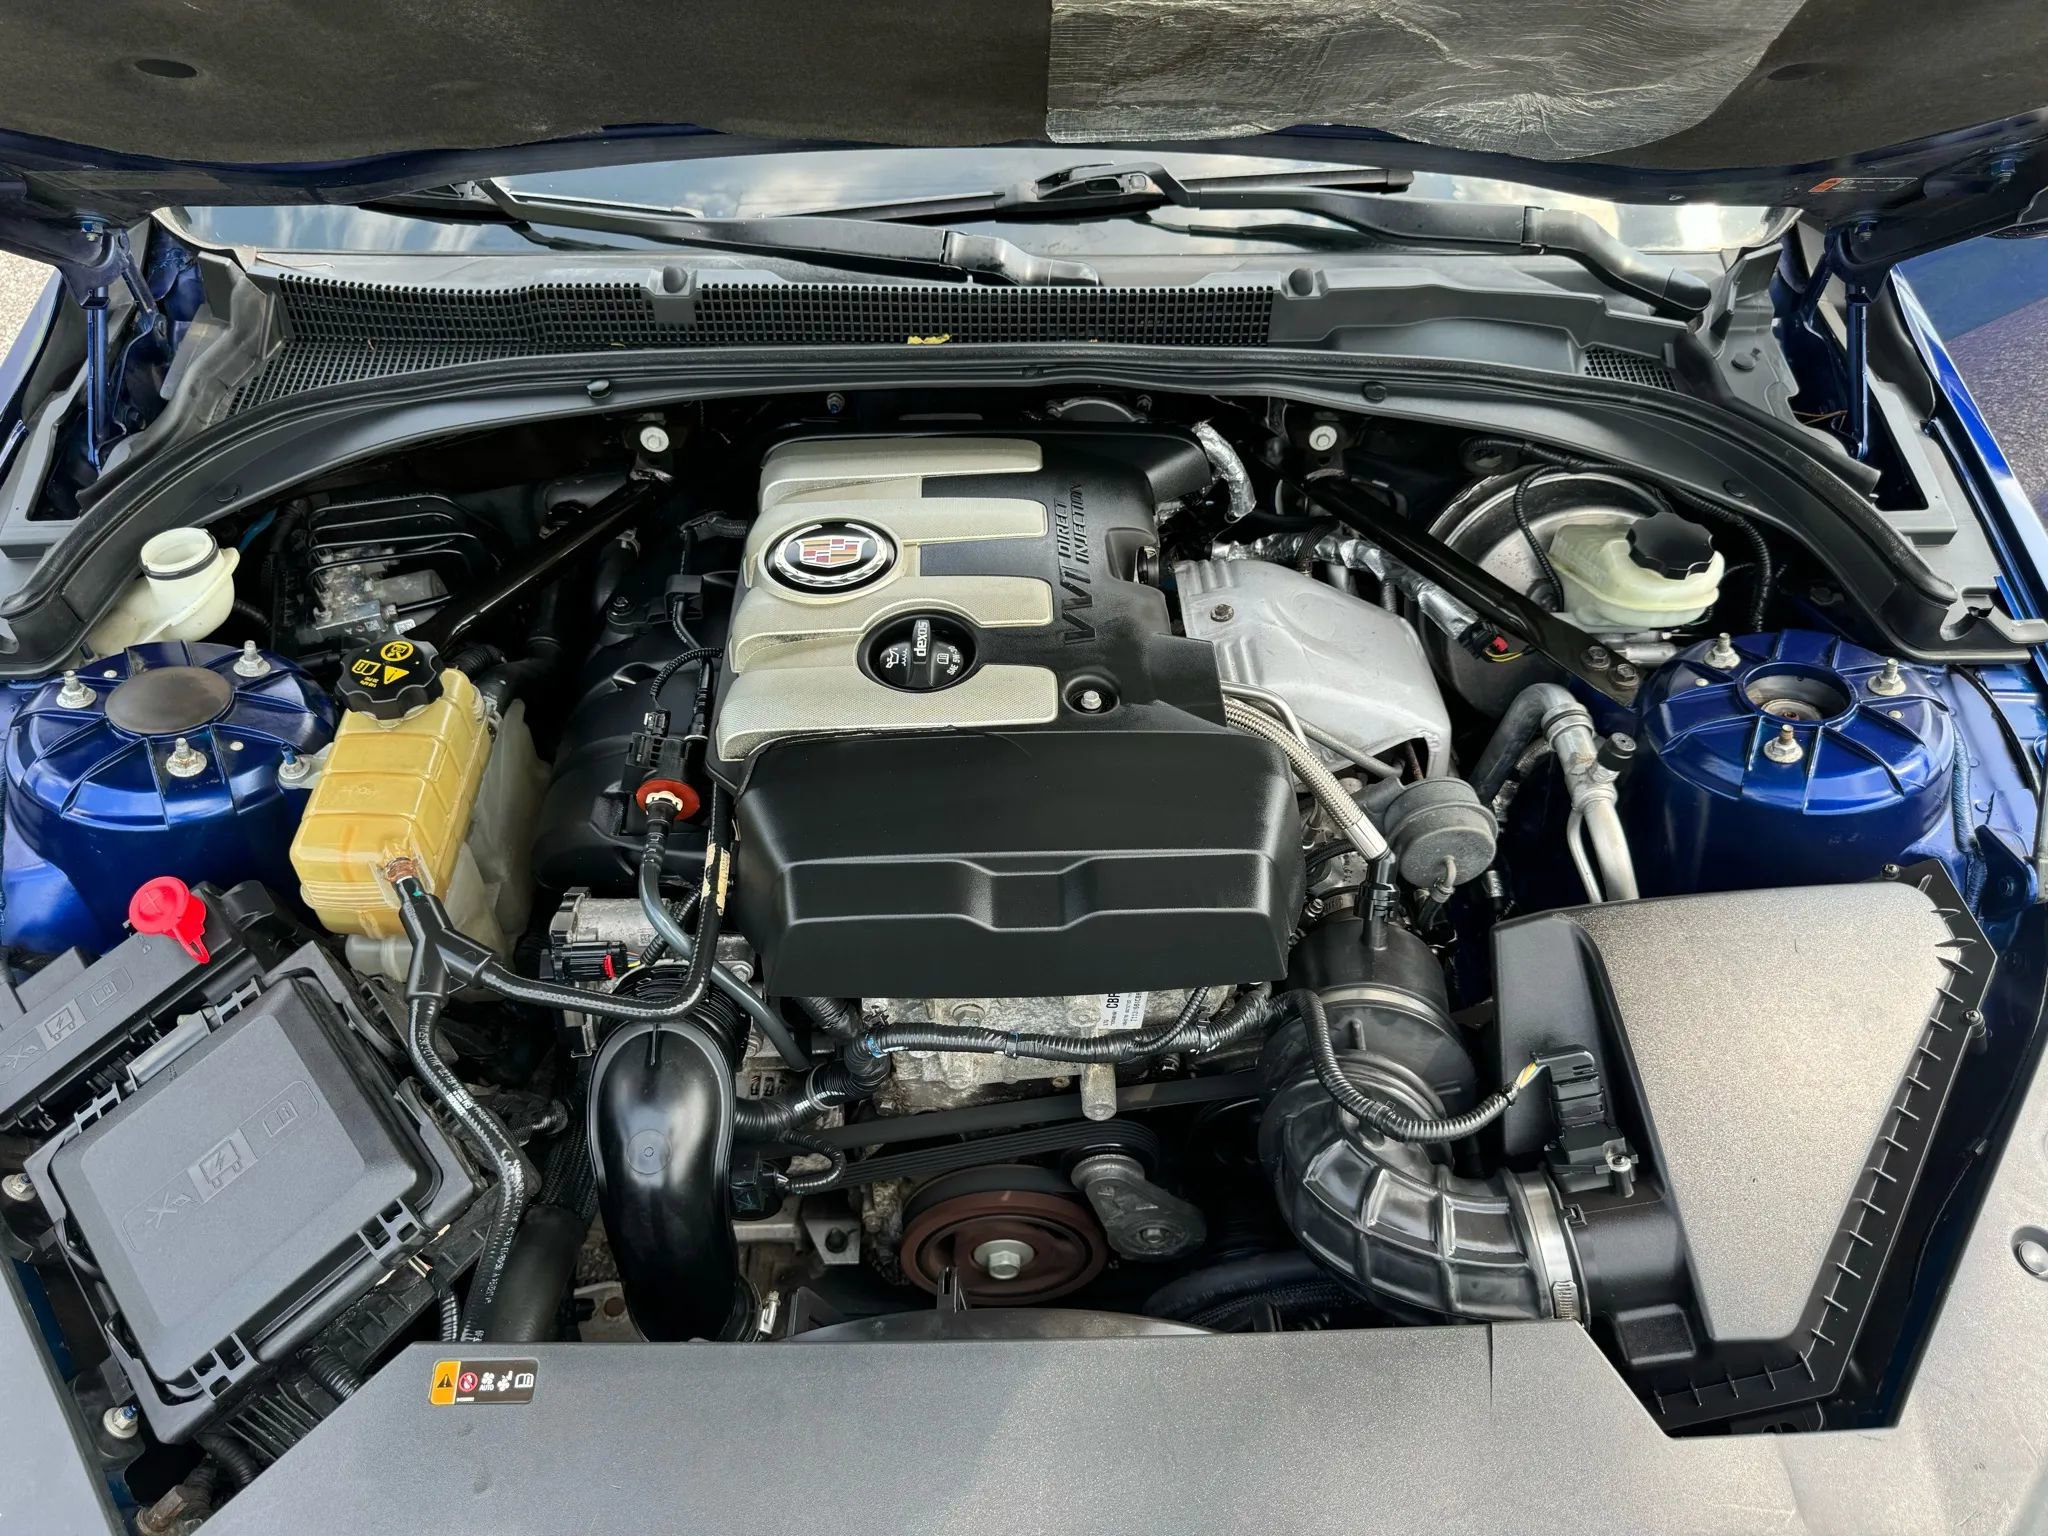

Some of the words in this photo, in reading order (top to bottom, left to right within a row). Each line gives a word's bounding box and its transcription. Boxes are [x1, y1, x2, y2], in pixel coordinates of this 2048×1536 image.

[1054, 497, 1072, 559] DIRECT
[1070, 483, 1090, 565] INJECTION
[1058, 558, 1096, 645] VVT
[913, 621, 928, 657] dexos
[946, 663, 959, 676] SAE
